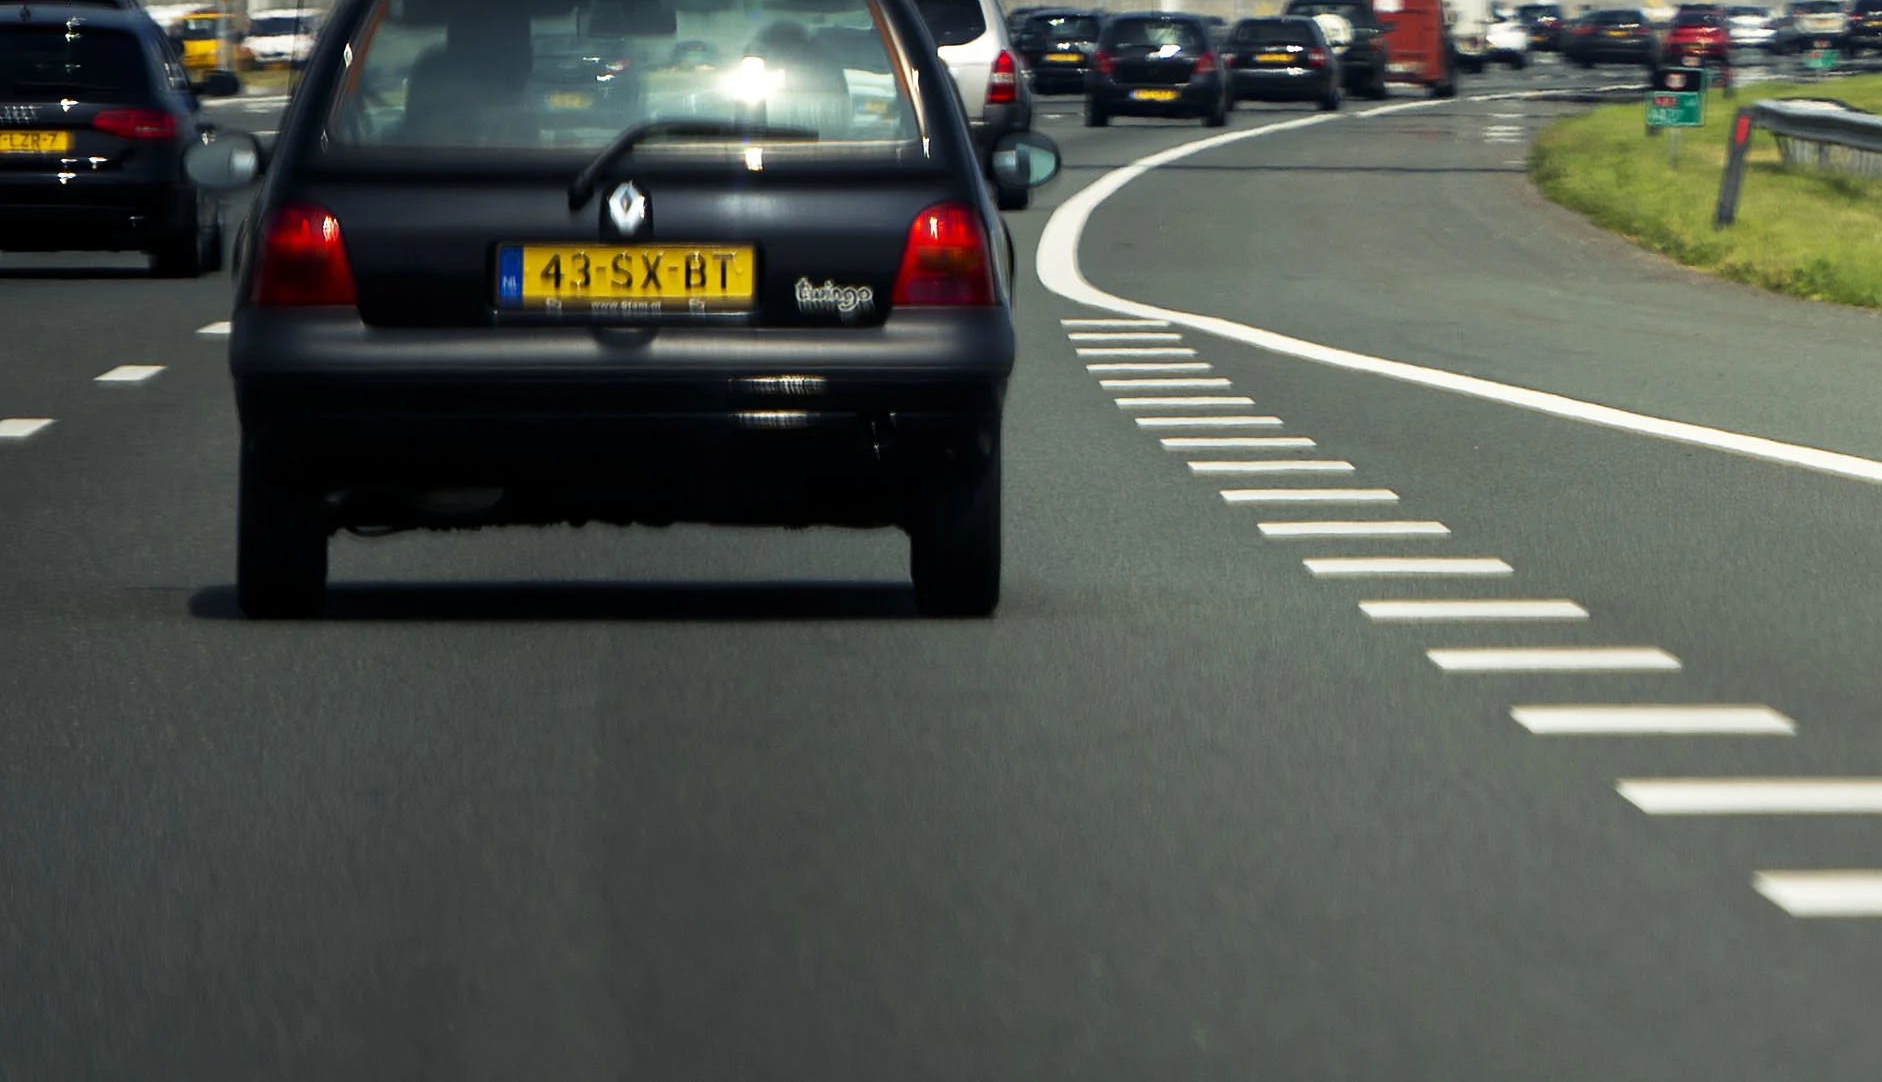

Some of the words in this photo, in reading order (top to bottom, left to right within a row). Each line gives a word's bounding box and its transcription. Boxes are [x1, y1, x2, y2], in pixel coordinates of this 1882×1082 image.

[0, 132, 58, 149] -LZR-7
[540, 251, 738, 291] 43-SX-BT
[795, 277, 874, 311] twingo
